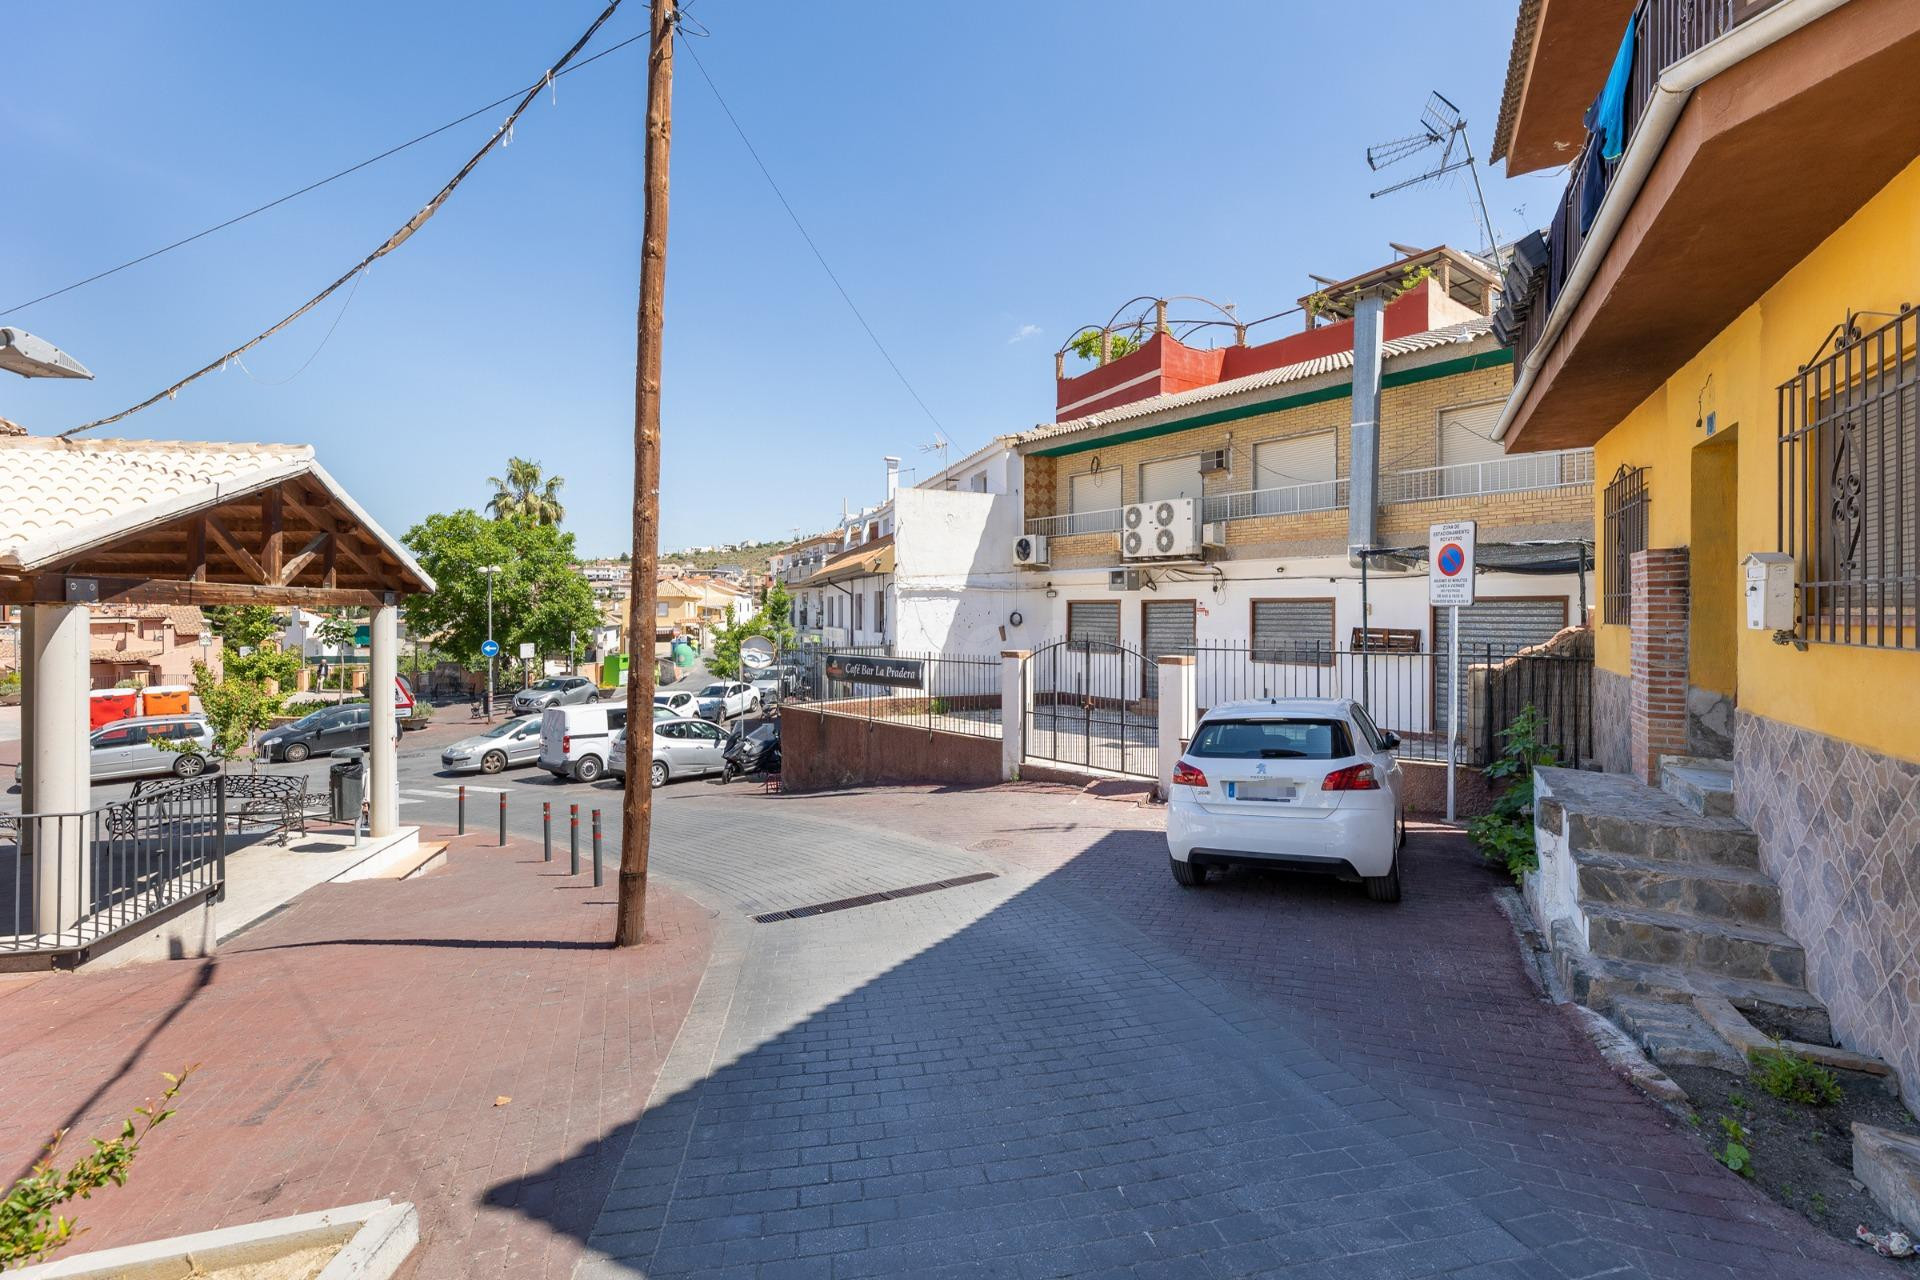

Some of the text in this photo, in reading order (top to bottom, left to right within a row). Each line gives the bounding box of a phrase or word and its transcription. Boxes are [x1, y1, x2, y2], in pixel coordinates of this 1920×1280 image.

[845, 663, 915, 679] Café Bar La Pradera
